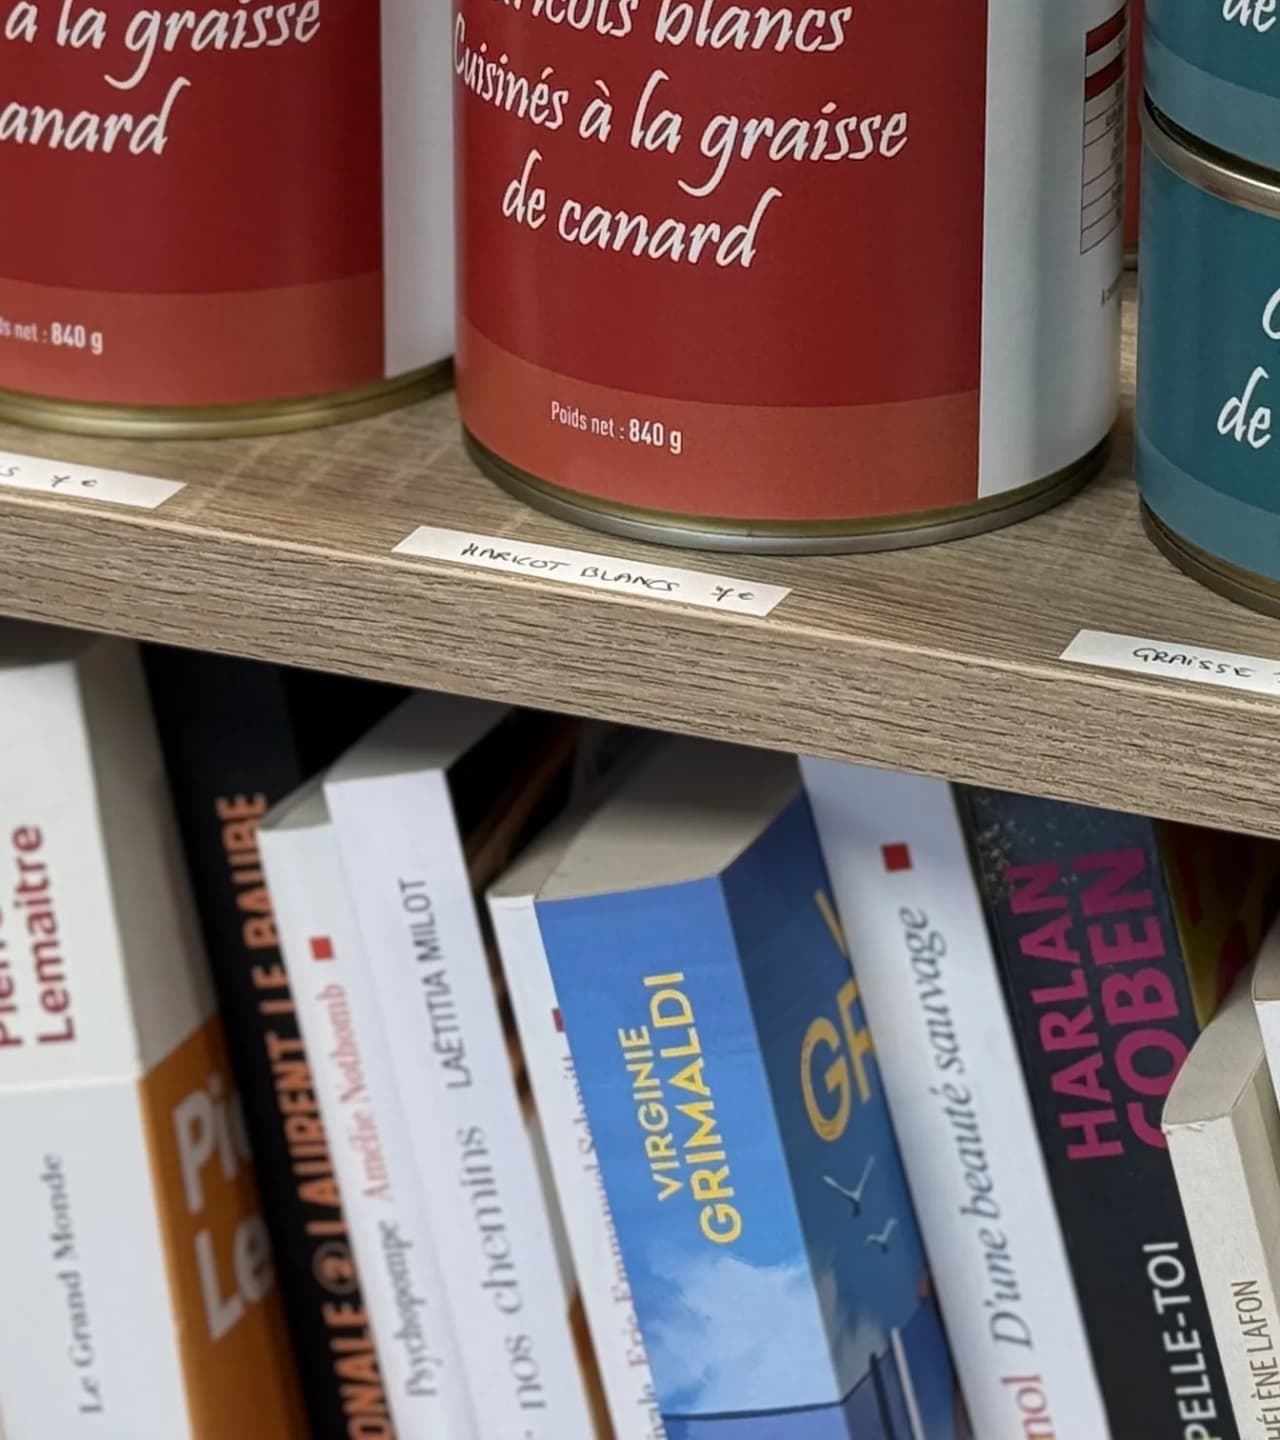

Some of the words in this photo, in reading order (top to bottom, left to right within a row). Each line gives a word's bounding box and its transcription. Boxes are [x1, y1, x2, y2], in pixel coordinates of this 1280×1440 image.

[452, 11, 571, 135] Cuisinés
[579, 79, 613, 145] à
[630, 68, 683, 155] la
[677, 100, 911, 198] graisse
[502, 148, 547, 231] de
[557, 186, 784, 269] canard
[13, 319, 40, 344] net
[50, 322, 87, 350] 840
[90, 330, 104, 355] g
[550, 399, 588, 432] Poids
[590, 415, 617, 440] net
[628, 417, 665, 448] 840
[668, 427, 683, 456] g
[1216, 365, 1272, 451] de
[460, 541, 572, 572] HARICOT
[579, 565, 680, 592] BLANCS
[12, 824, 77, 1045] Lemaitre
[397, 878, 447, 963] MILOT
[327, 981, 368, 1106] Nothomb
[897, 906, 966, 1075] sauvage
[1000, 860, 1126, 1162] HARLAN
[616, 1024, 685, 1203] VIRGINIE
[641, 971, 744, 1244] GRIMALDI
[926, 1083, 1001, 1222] beauté
[39, 1154, 79, 1262] Monde
[461, 1127, 521, 1315] chemins
[60, 1261, 95, 1371] Grand
[376, 1218, 440, 1400] Psychopompe
[973, 1226, 1036, 1351] D'une
[1231, 1279, 1276, 1354] LAFON
[79, 1378, 105, 1415] Le
[503, 1335, 546, 1411] nos
